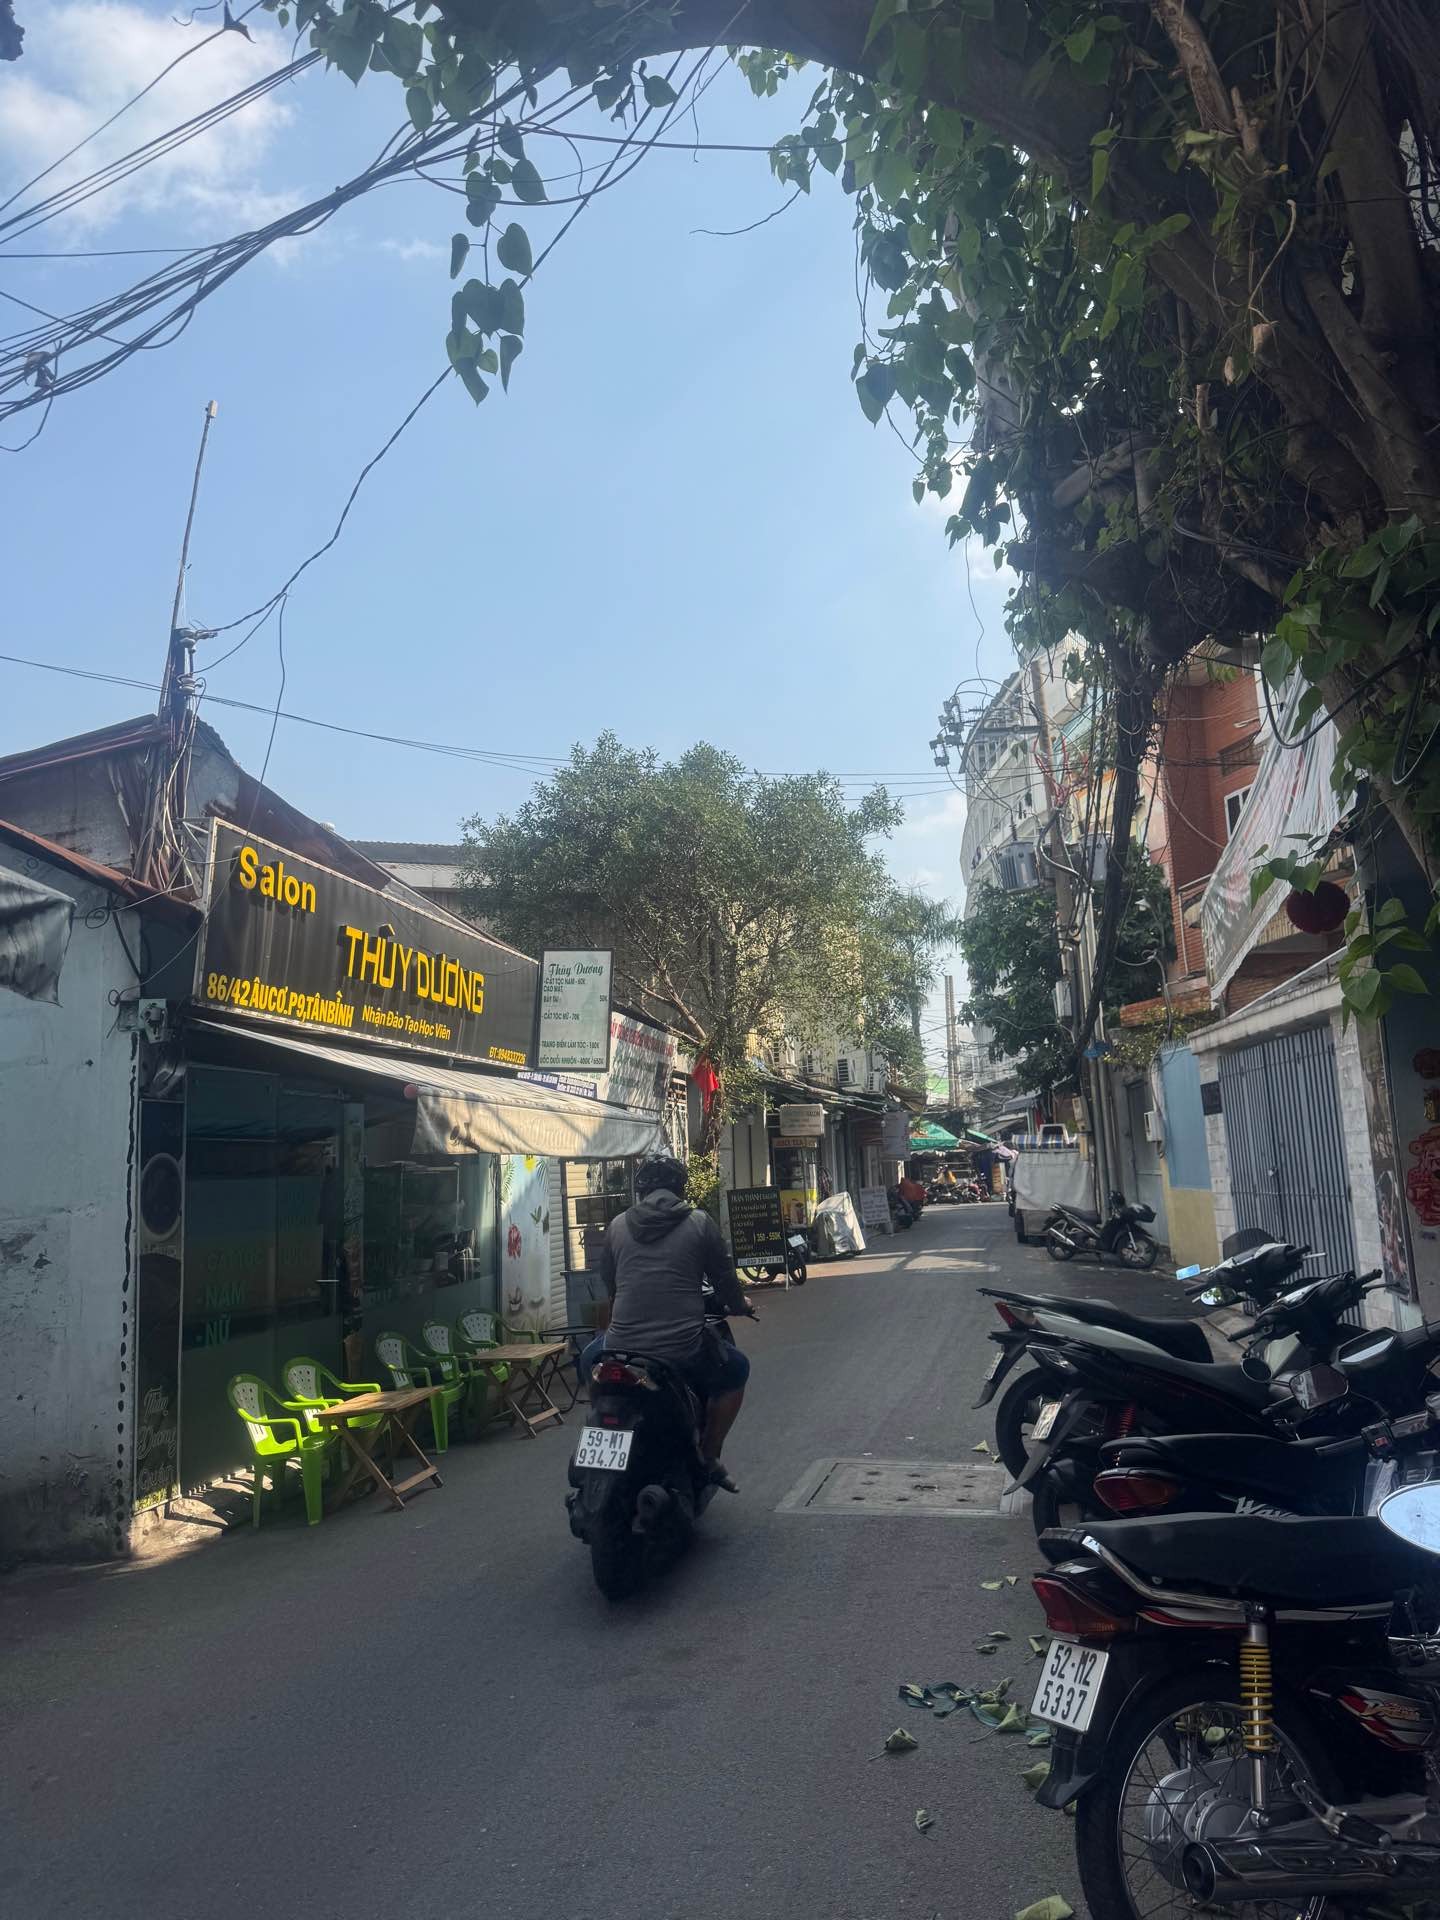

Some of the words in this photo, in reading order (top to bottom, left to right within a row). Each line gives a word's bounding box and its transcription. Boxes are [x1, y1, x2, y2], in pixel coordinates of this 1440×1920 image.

[239, 846, 316, 913] Salon
[417, 951, 485, 1014] DƯƠNG
[362, 1004, 386, 1028] Nhận
[386, 1010, 404, 1029] Đào
[404, 1014, 419, 1035] Tạo
[419, 1018, 435, 1038] Học
[435, 1022, 451, 1040] Viên
[578, 1448, 627, 1468] 934.78
[587, 1430, 625, 1449] 59-N1
[1040, 1680, 1088, 1724] 5337
